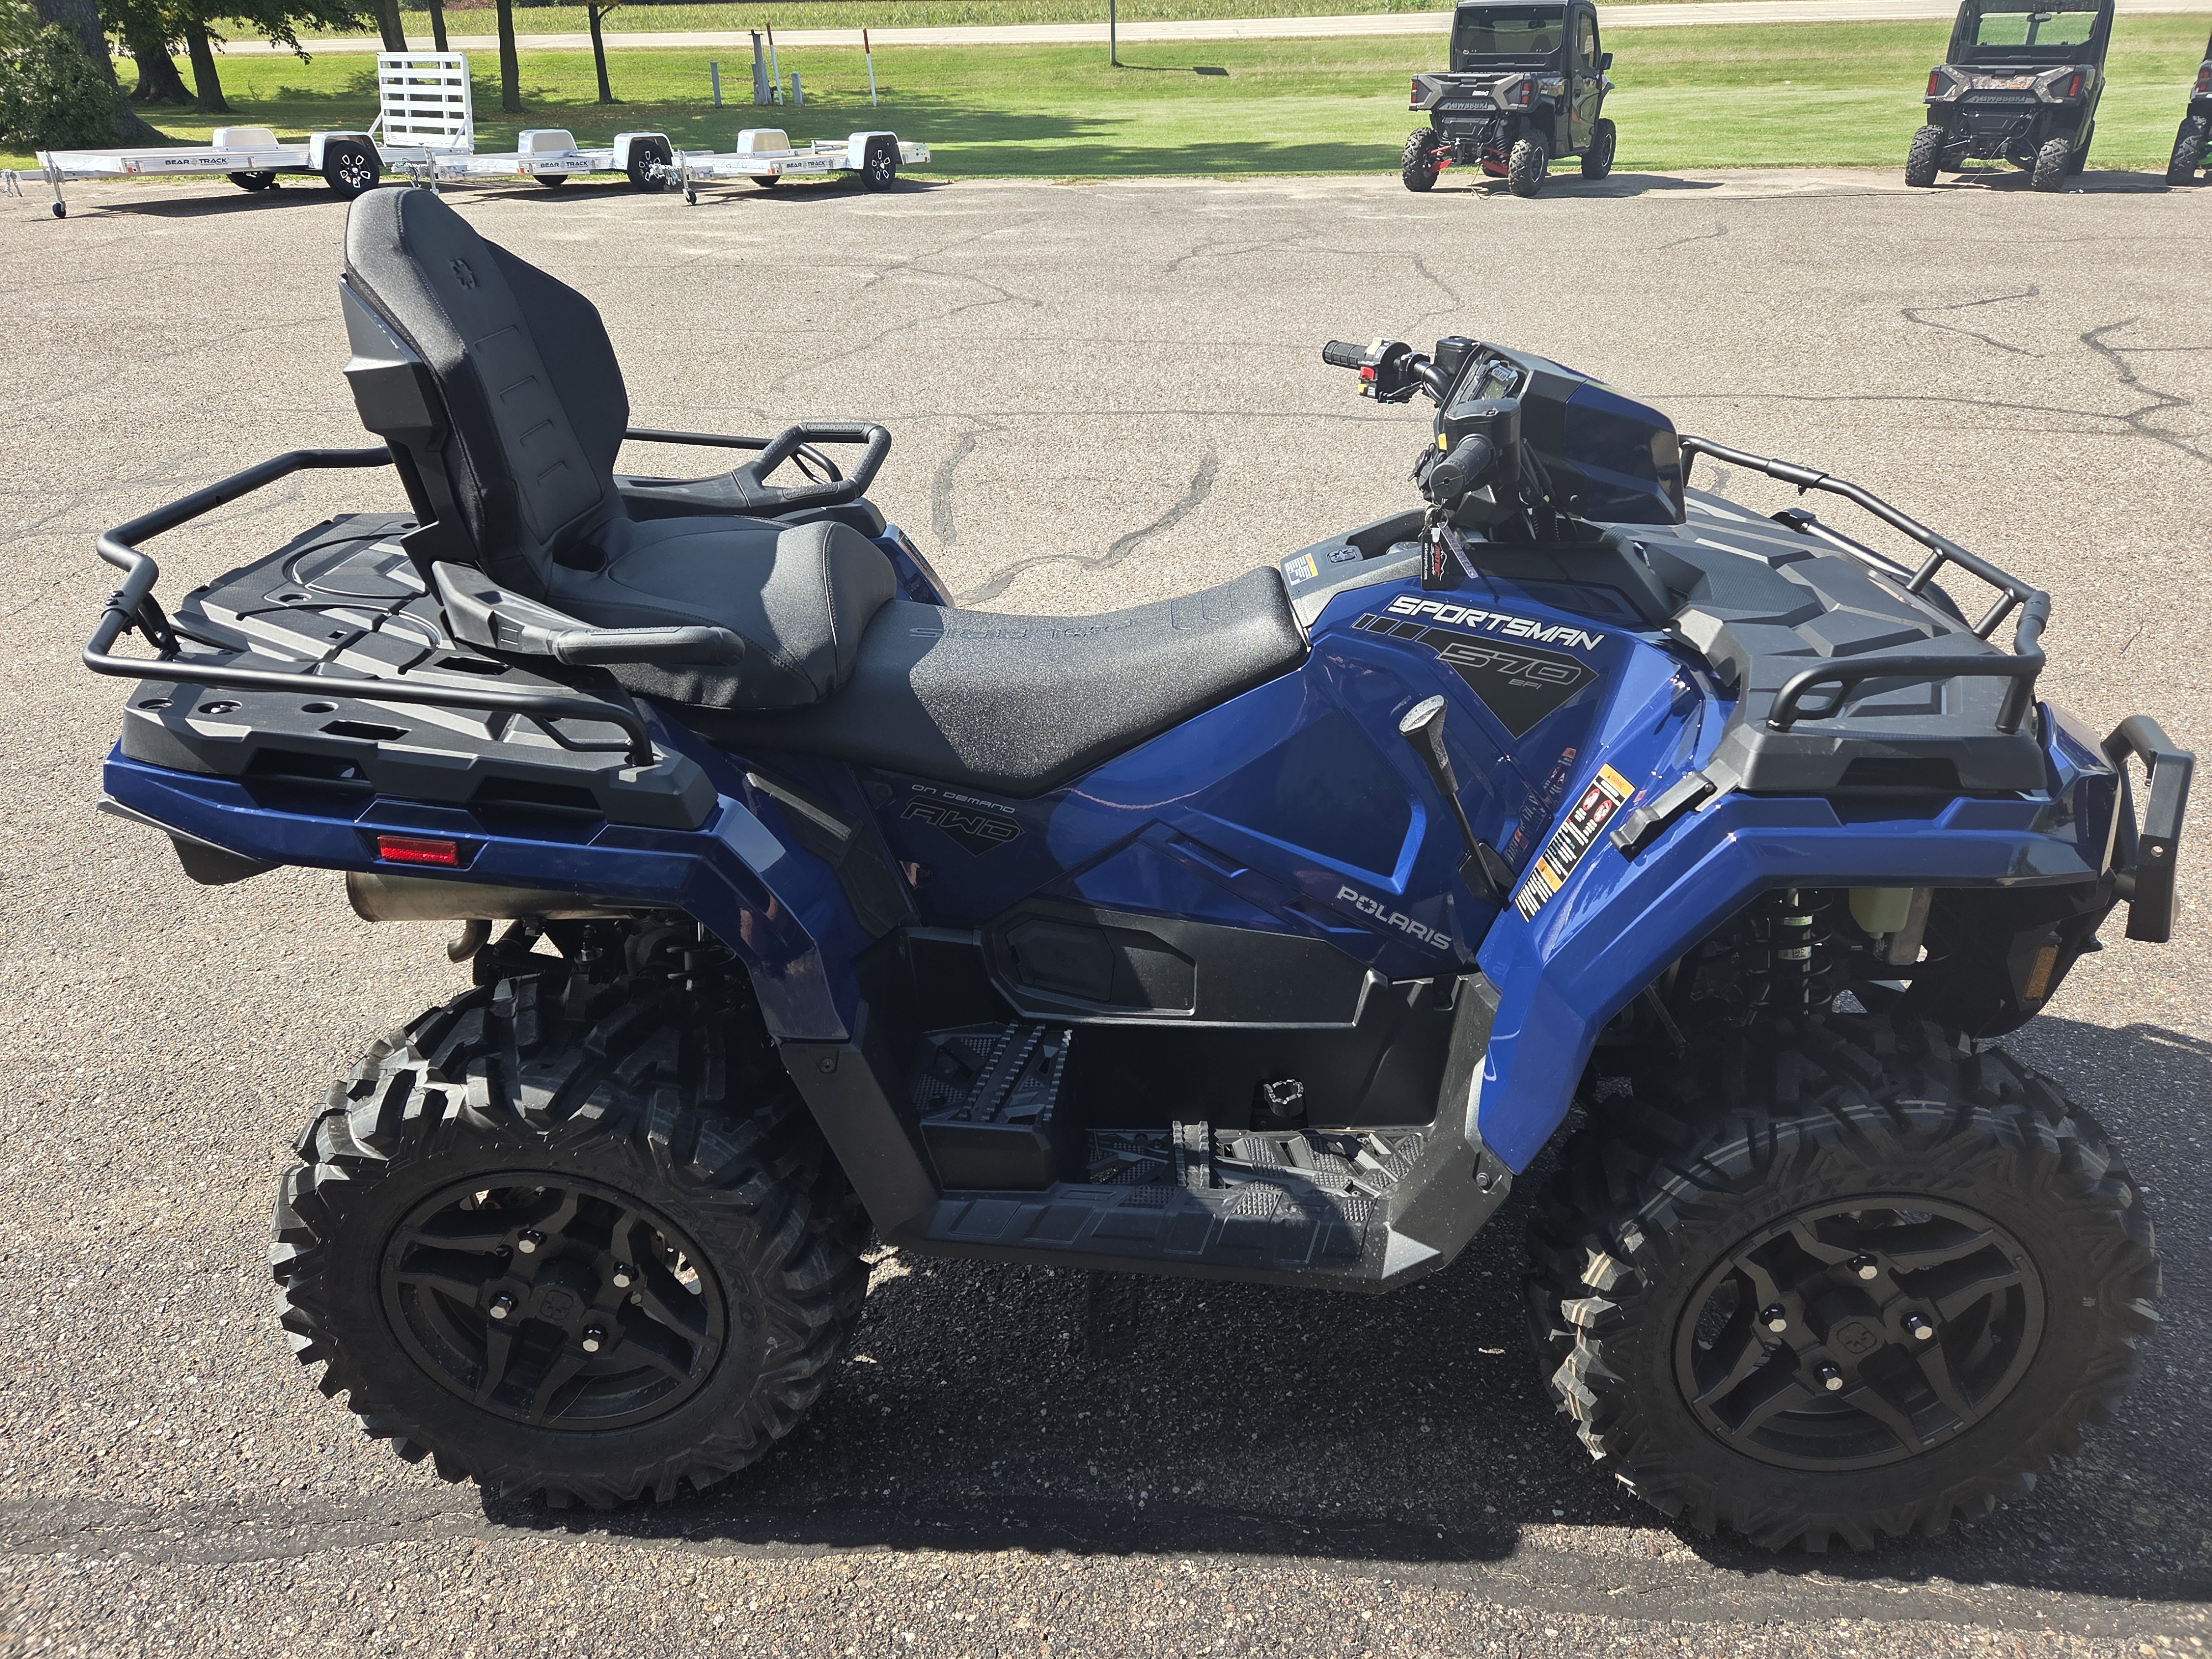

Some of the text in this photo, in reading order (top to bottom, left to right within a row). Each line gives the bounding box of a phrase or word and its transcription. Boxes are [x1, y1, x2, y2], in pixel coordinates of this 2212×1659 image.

[1387, 595, 1605, 651] SPORTSMAN
[1436, 642, 1582, 685] 570
[1508, 679, 1543, 690] EFI
[900, 802, 1021, 843] AWD
[942, 791, 1016, 814] DEMAND
[1336, 885, 1452, 951] POLARIS
